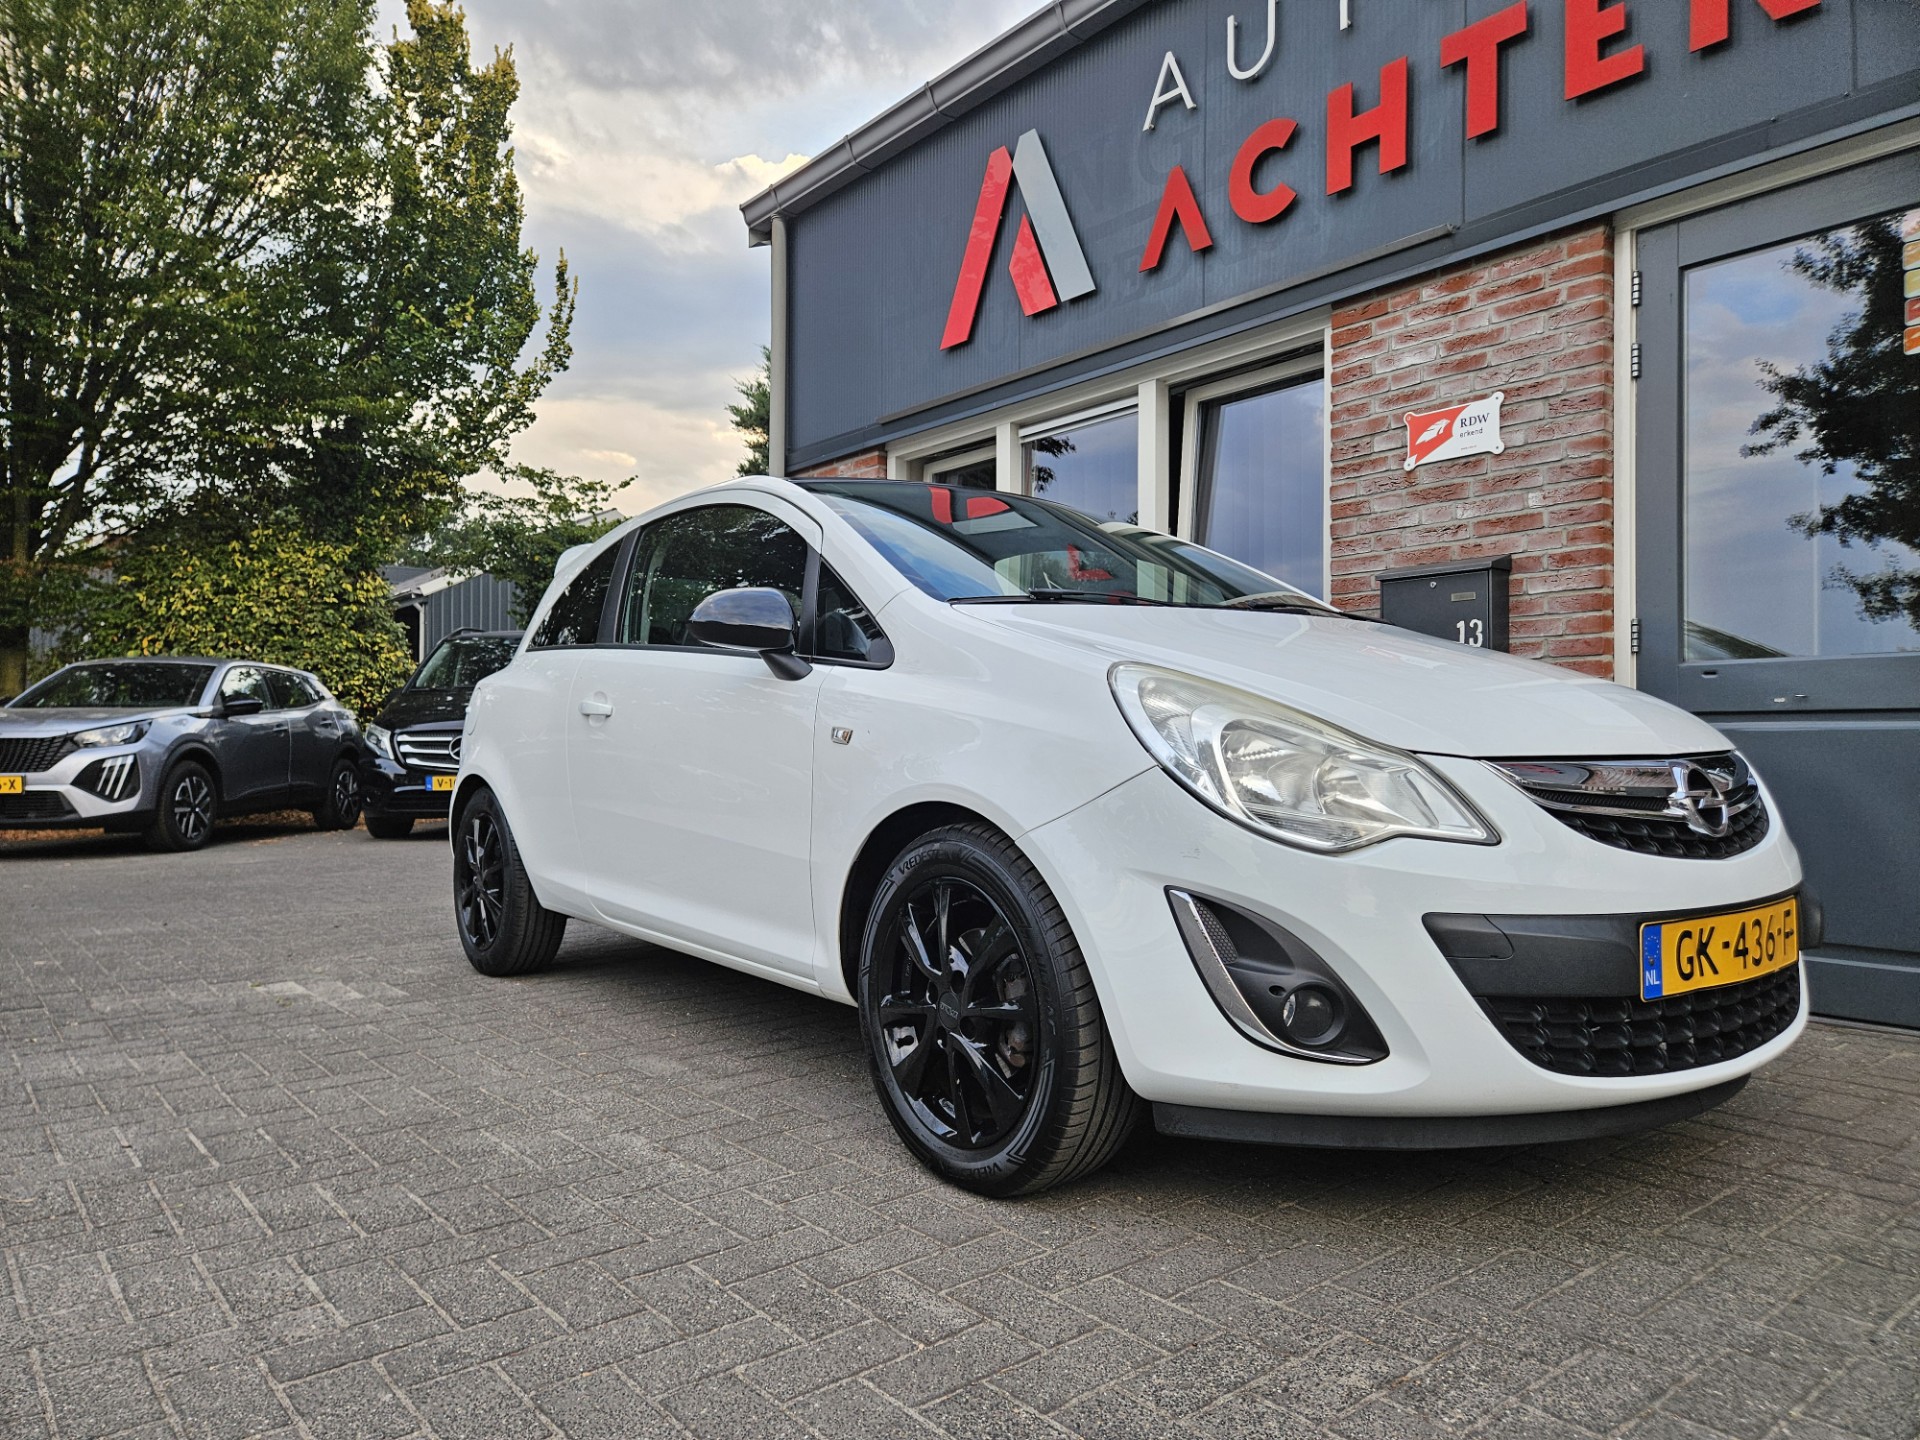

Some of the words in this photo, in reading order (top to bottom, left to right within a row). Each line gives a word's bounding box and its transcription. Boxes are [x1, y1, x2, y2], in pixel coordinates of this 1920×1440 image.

[1460, 412, 1490, 428] RDW
[1459, 427, 1483, 438] erkend
[1456, 619, 1483, 647] 13
[437, 778, 456, 788] V-1
[1675, 908, 1794, 981] GK-436-F
[1645, 970, 1660, 987] NL
